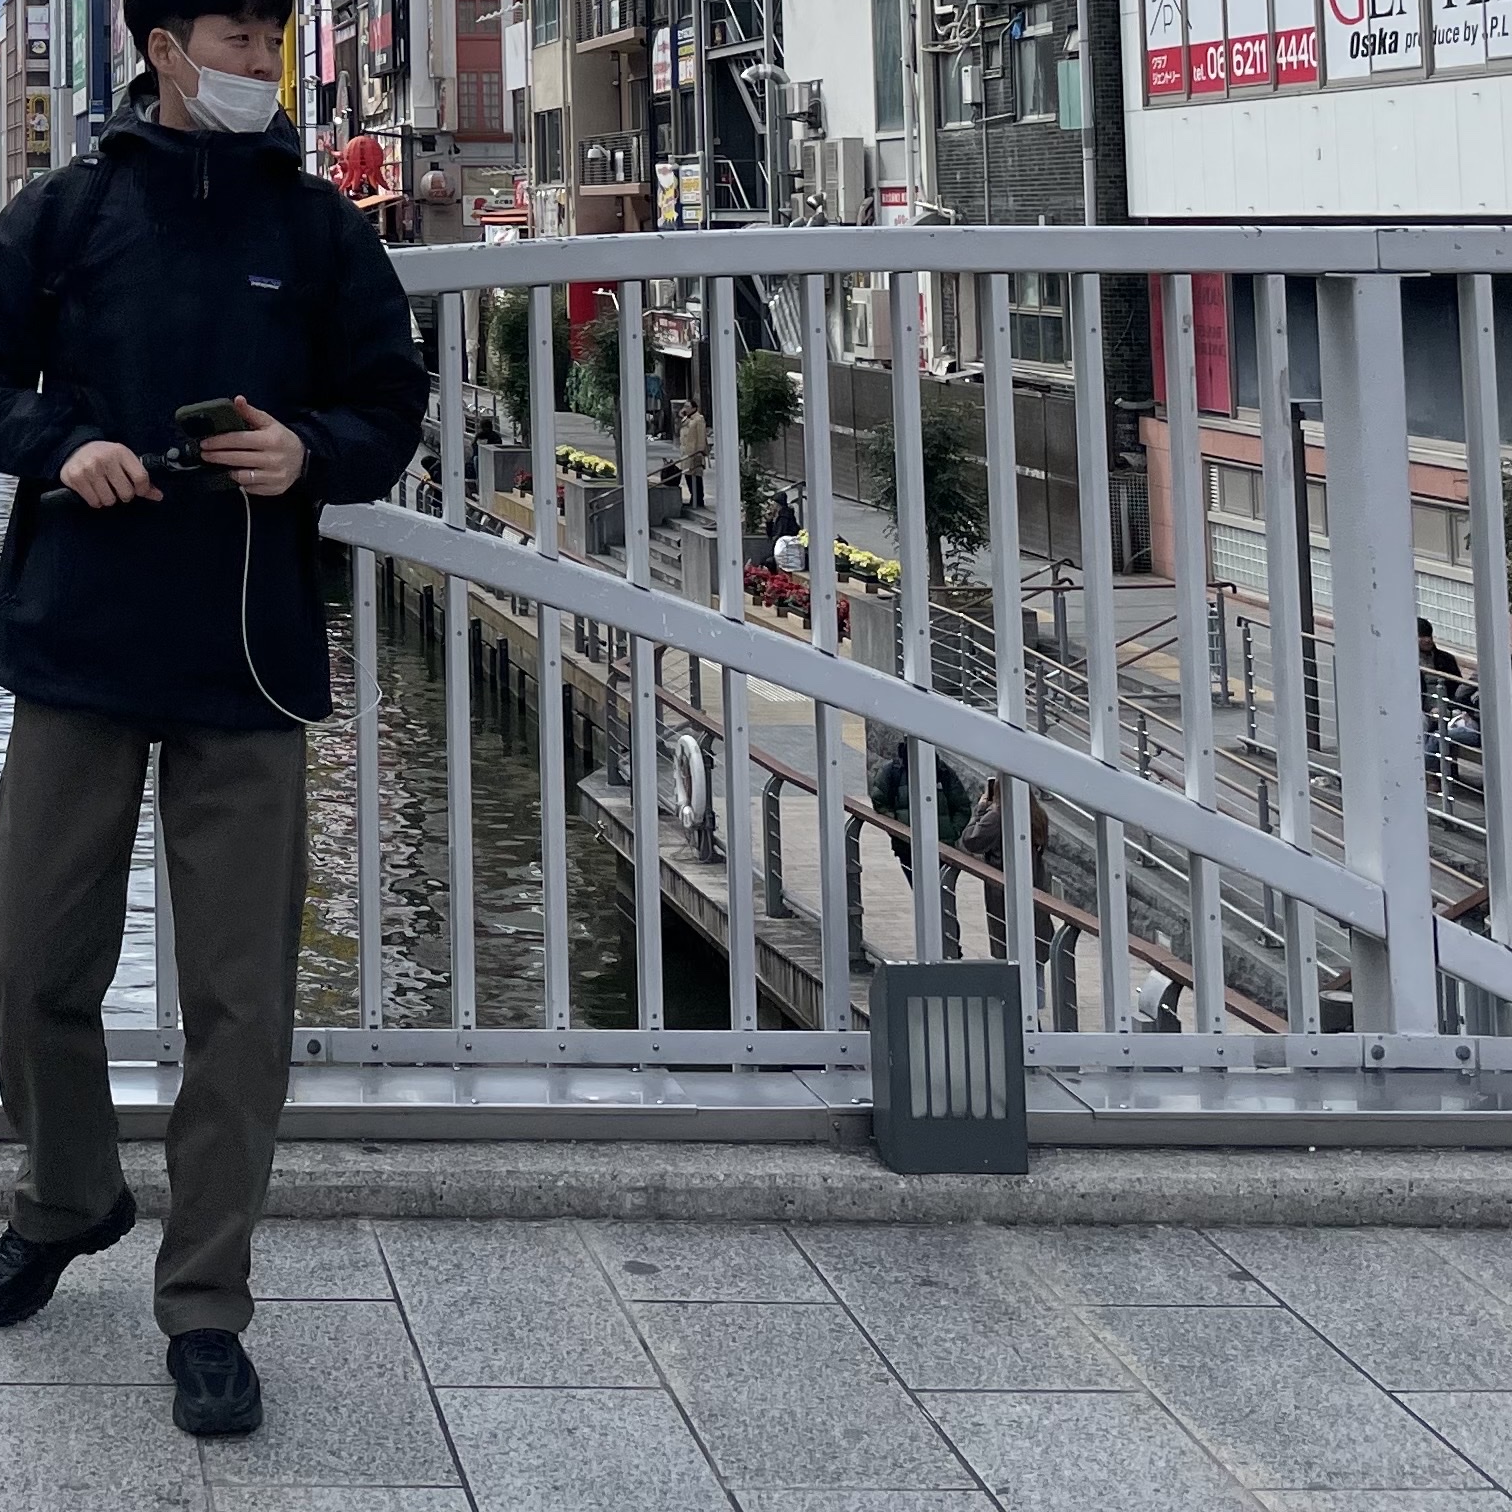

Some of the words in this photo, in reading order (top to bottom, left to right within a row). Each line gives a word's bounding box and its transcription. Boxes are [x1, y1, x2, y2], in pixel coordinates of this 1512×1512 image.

[1206, 44, 1225, 80] 06
[1232, 38, 1268, 77] 6211
[1349, 27, 1399, 59] Osaka
[1464, 20, 1479, 46] by
